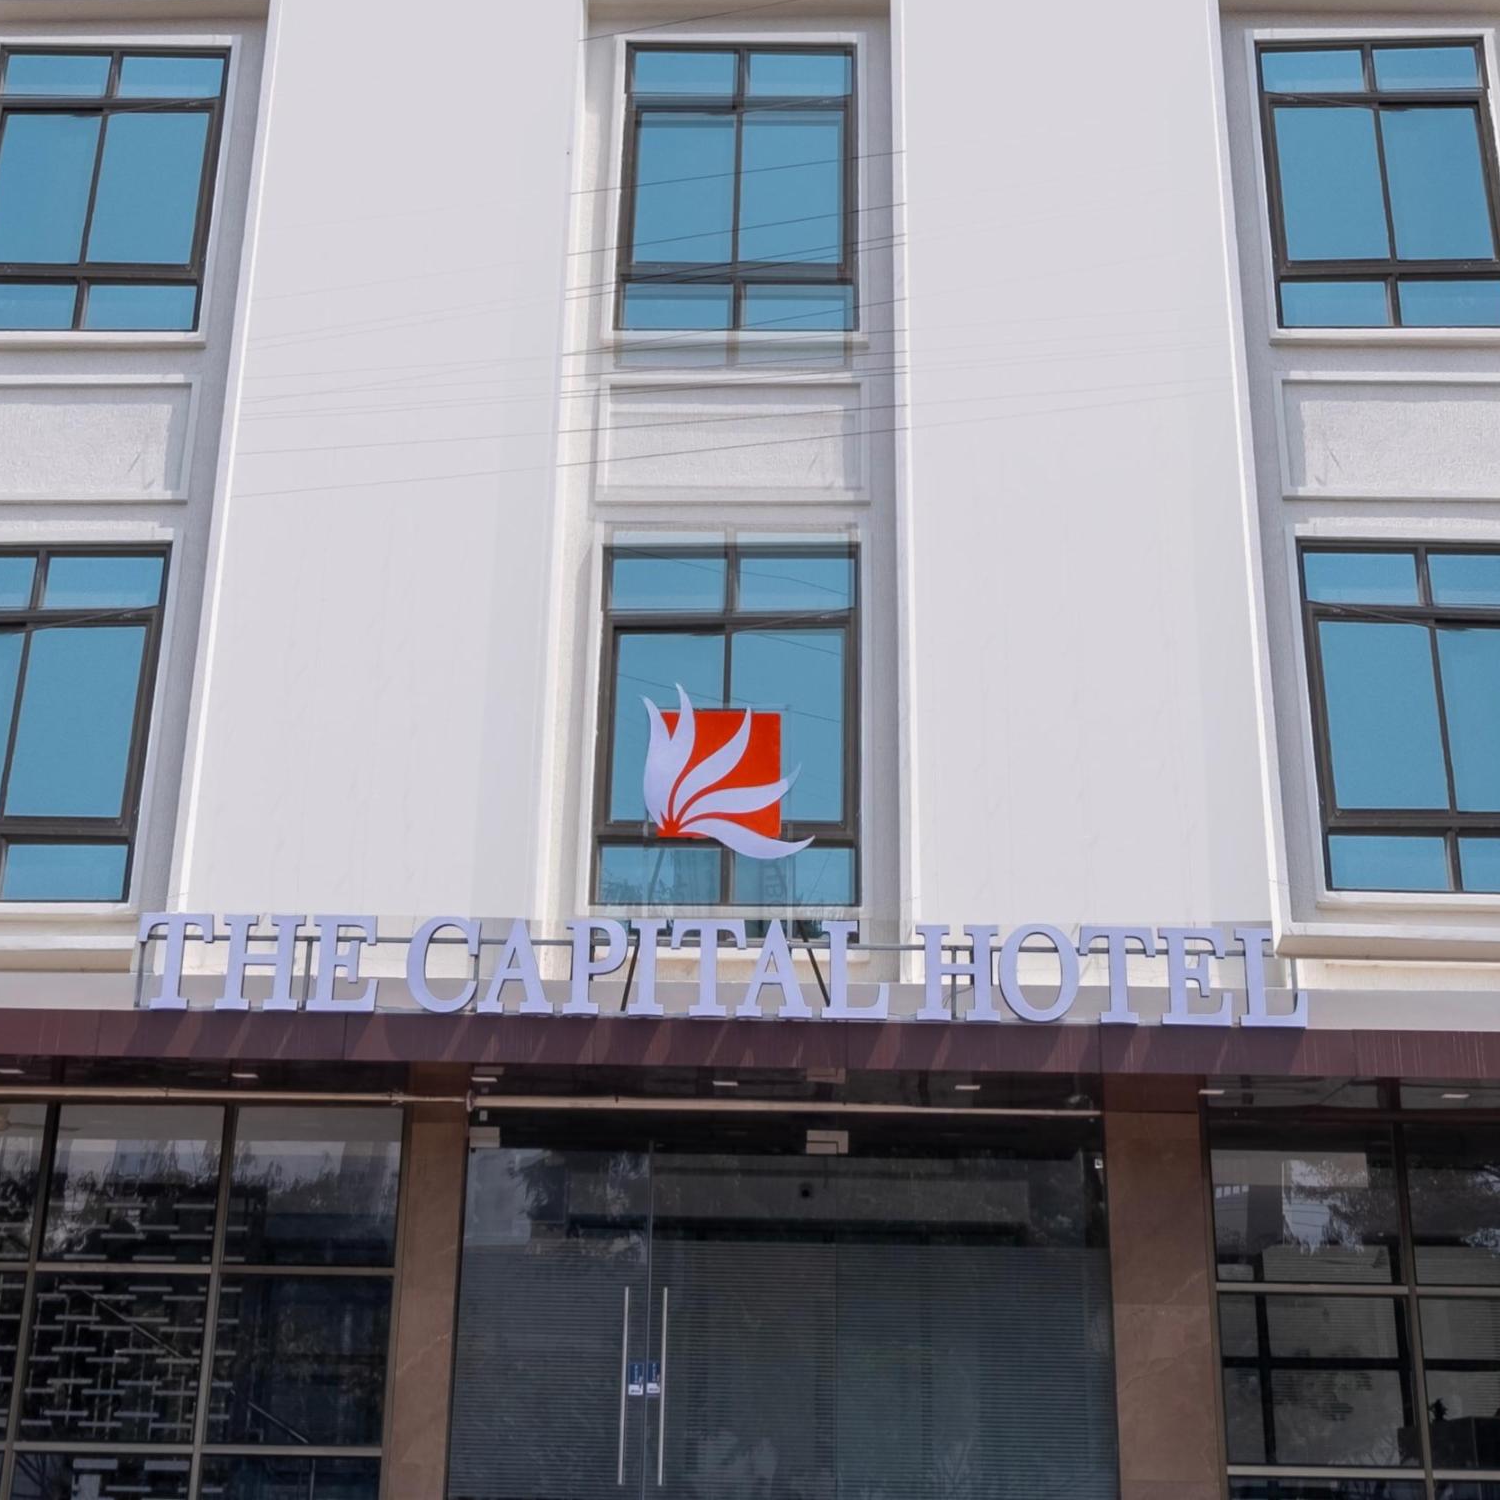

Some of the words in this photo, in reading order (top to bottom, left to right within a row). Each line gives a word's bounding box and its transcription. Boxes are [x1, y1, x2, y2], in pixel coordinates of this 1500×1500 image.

[138, 912, 379, 1013] THE
[405, 916, 890, 1022] CAPITAL
[912, 923, 1310, 1030] HOTEL
